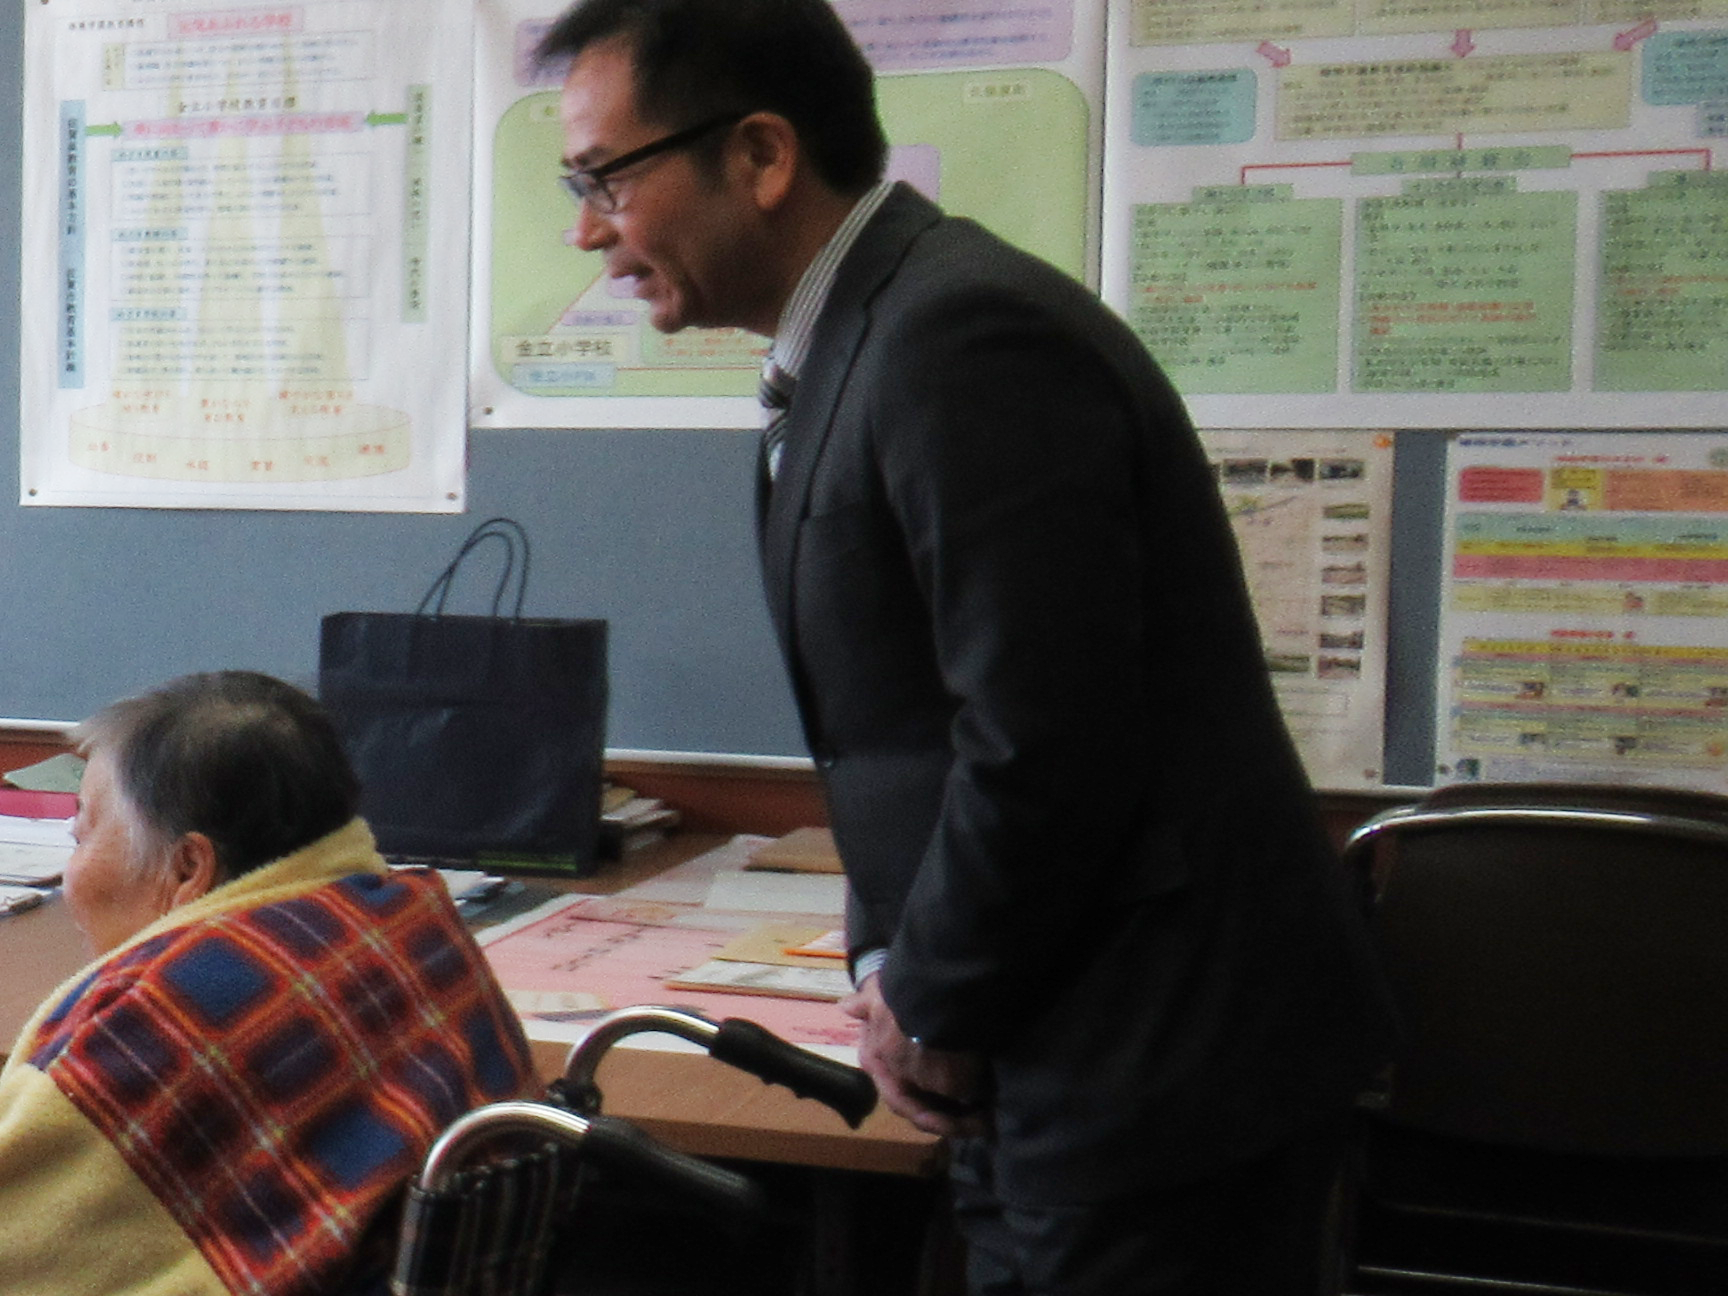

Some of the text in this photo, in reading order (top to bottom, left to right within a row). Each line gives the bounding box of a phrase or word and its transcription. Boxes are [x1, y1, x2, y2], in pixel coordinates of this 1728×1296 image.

[514, 339, 614, 359] 金立小学校
